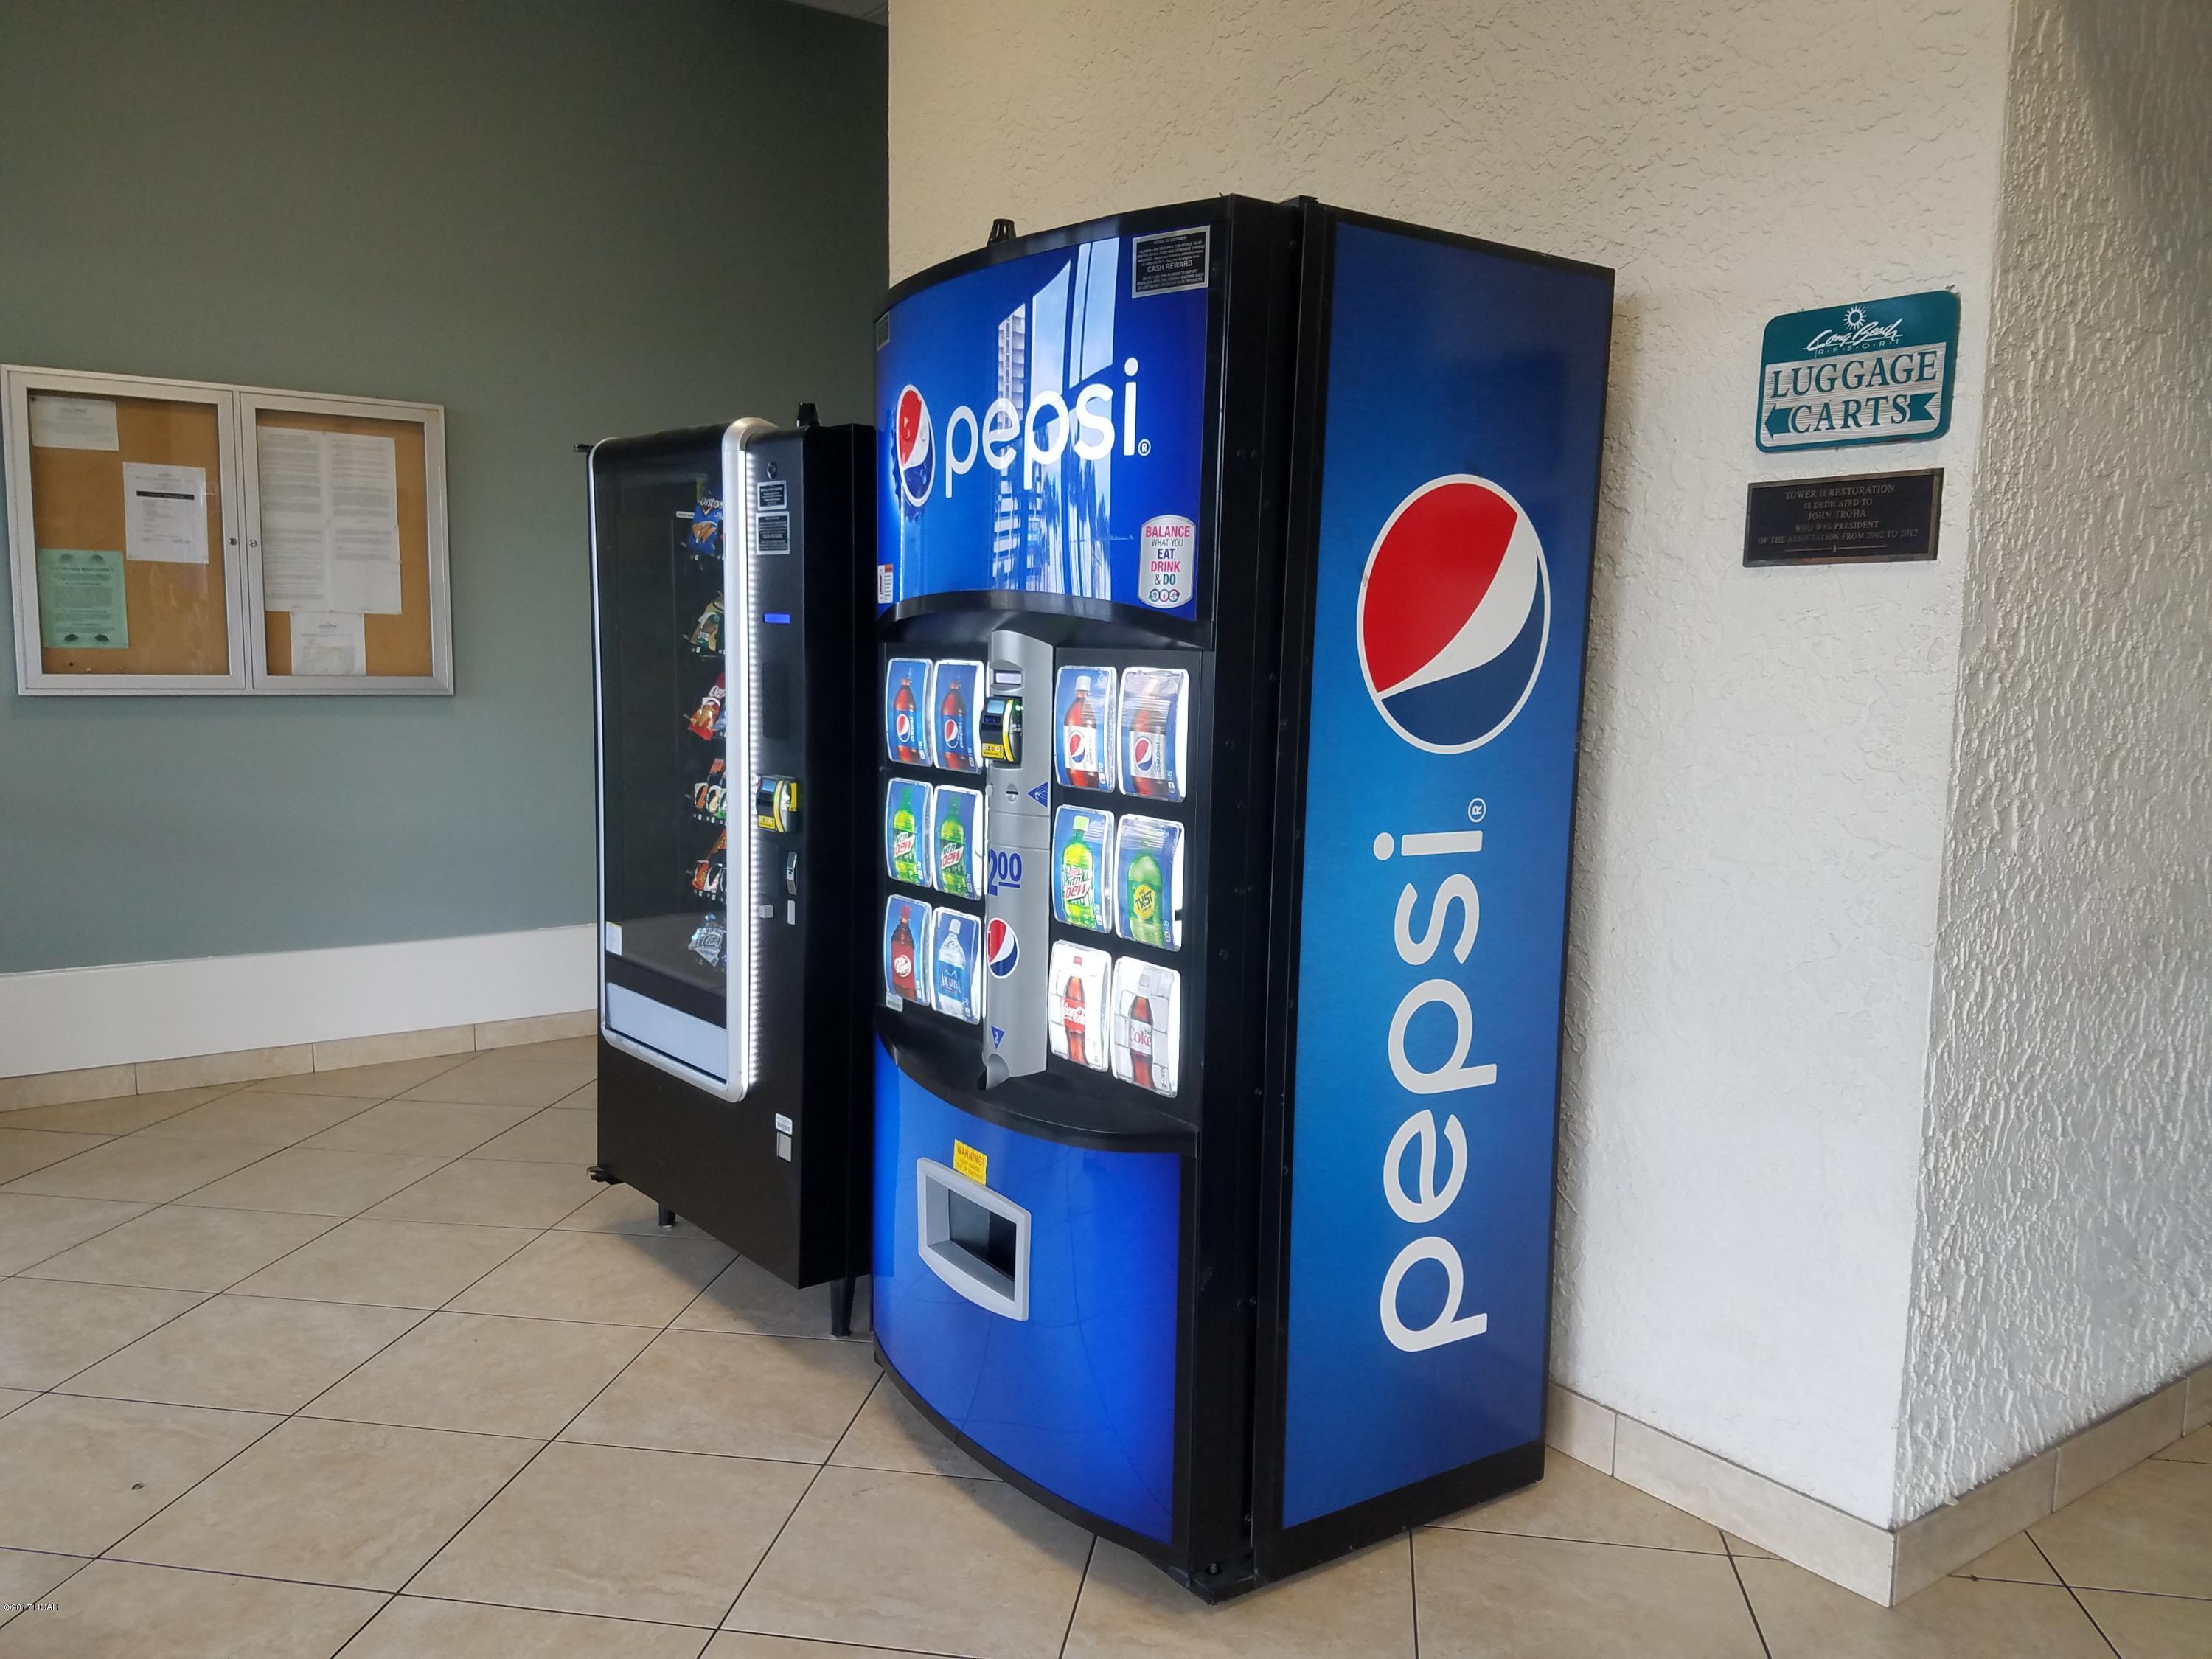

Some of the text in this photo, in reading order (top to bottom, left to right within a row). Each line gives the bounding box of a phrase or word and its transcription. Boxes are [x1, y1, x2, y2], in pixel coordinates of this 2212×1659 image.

[1147, 264, 1164, 273] CASH
[1165, 260, 1193, 270] REWARD
[1806, 318, 1903, 351] Long Beach
[1770, 350, 1938, 398] LUGGAGE
[1791, 394, 1908, 434] CARTS
[945, 357, 1139, 499] pepsi
[1786, 490, 1816, 501] TOWER
[1829, 484, 1895, 497] RESTORATION
[1804, 501, 1811, 509] IS
[1813, 499, 1860, 509] DEDICATED
[1807, 509, 1866, 521] JOHN TROHA
[1145, 526, 1191, 538] BALANCE
[1795, 521, 1879, 532] WHO WAS PRESIDENT
[1151, 538, 1183, 546] WHAT YOU
[1842, 532, 1864, 540] FROM
[1151, 561, 1180, 572] DRINK
[1154, 574, 1176, 585] & DO
[1373, 830, 1498, 1352] pepsi
[956, 1144, 984, 1168] WARNING!
